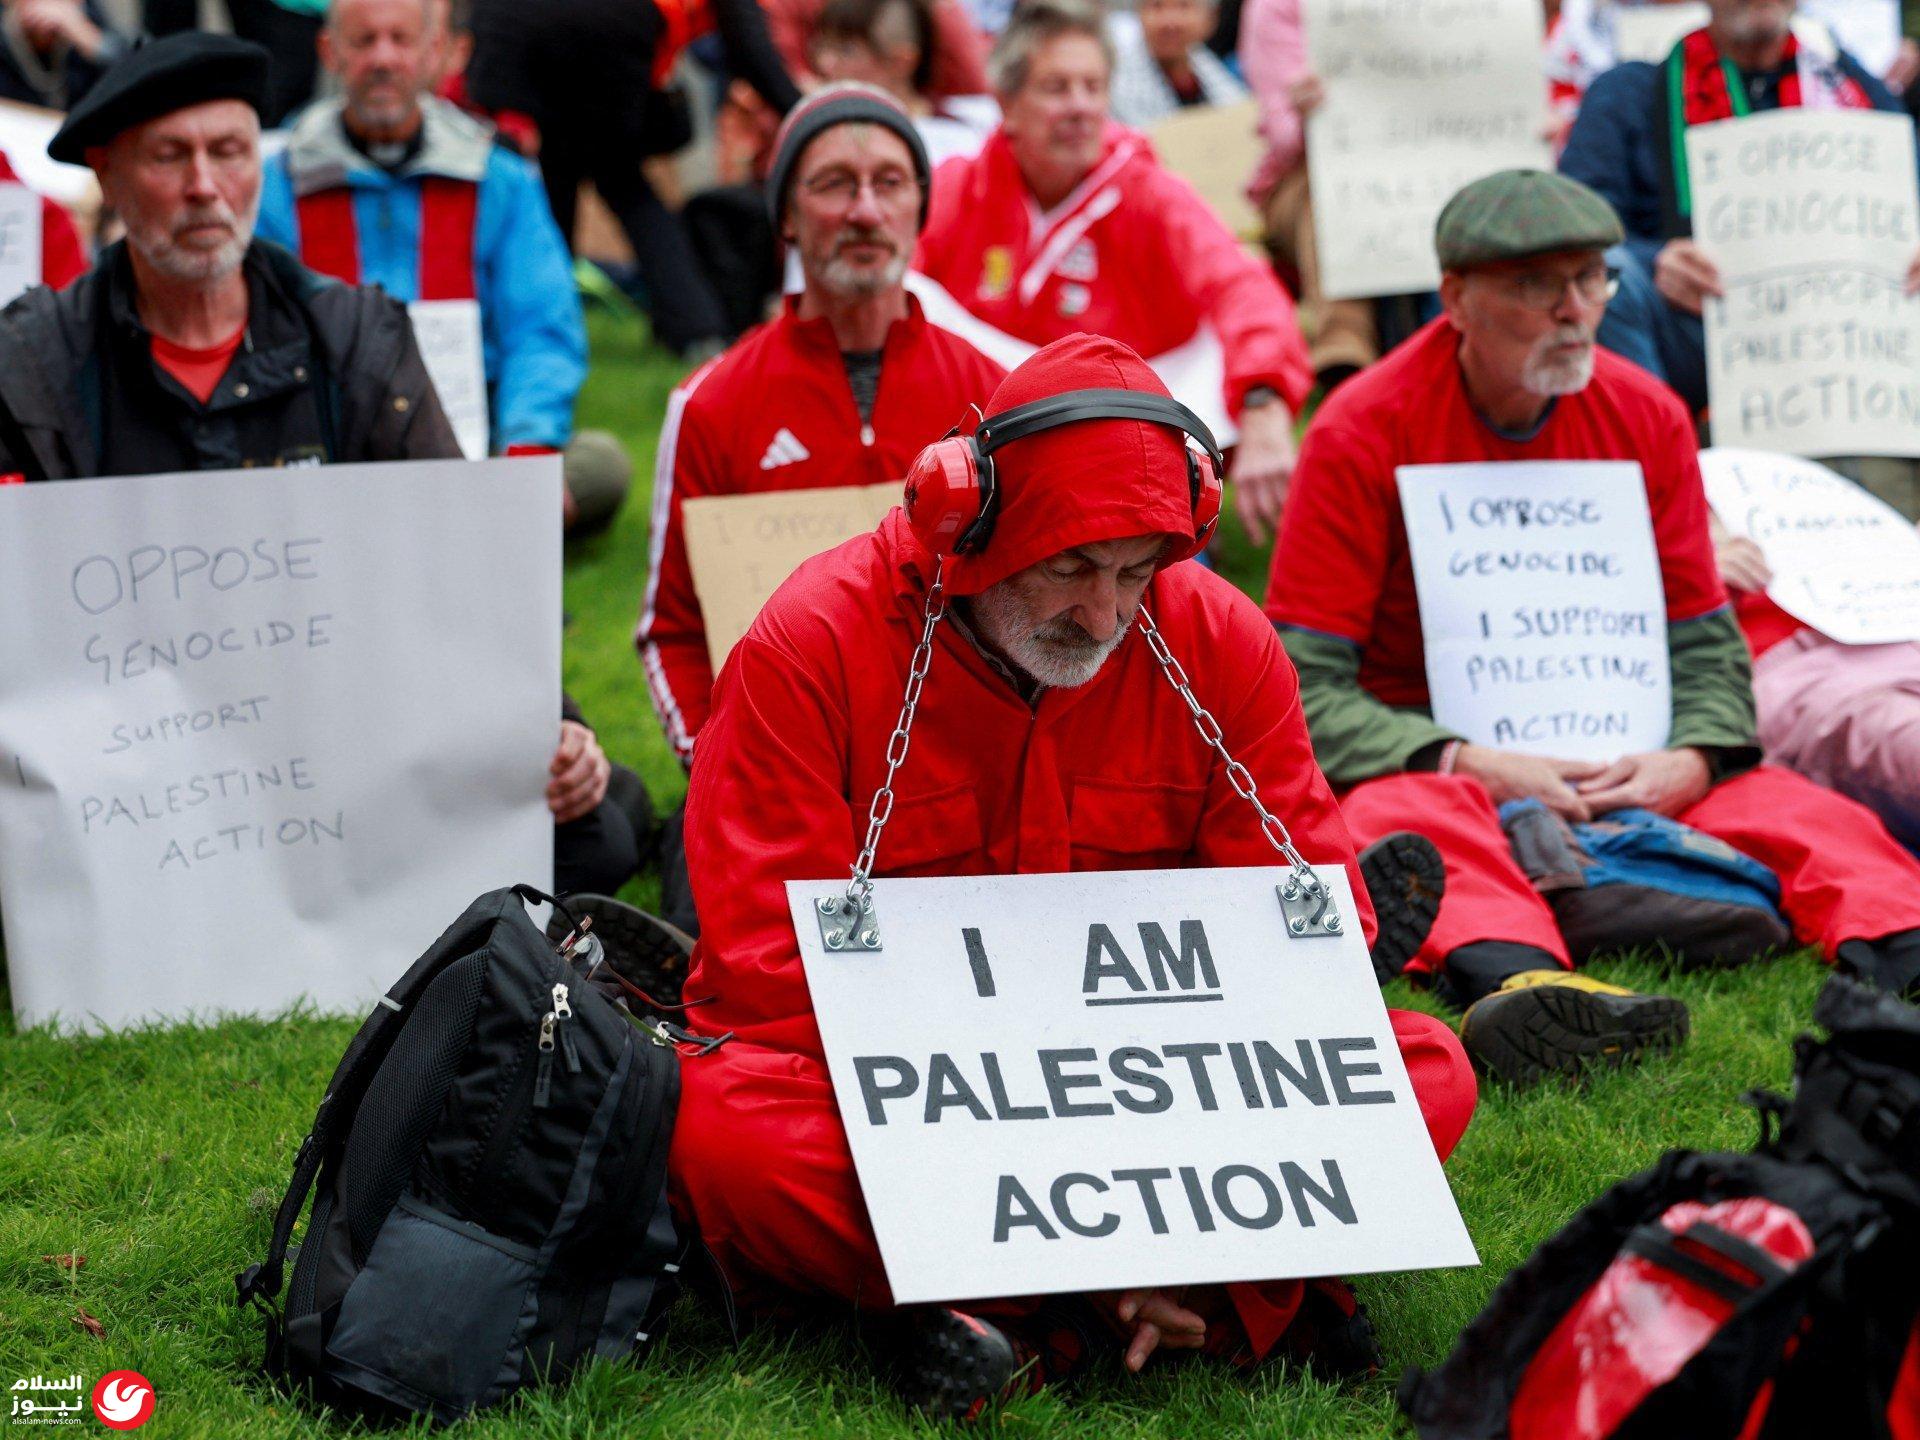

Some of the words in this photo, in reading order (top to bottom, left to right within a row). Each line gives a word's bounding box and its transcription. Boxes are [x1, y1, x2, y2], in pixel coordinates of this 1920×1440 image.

[1738, 131, 1877, 177] OPPOSE
[71, 537, 324, 615] OPPOSE
[1450, 551, 1623, 577] GENOCIDE
[83, 614, 333, 685] GENOCIDE
[1479, 611, 1490, 640] I
[1514, 605, 1648, 639] SUPPORT
[1466, 654, 1658, 693] PALESTINE
[102, 695, 270, 754] SUPPORT
[1494, 711, 1629, 743] ACTION
[81, 756, 316, 834] PALESTINE
[159, 810, 345, 869] ACTION
[962, 927, 996, 997] I
[1082, 919, 1222, 995] AM
[852, 1036, 1396, 1125] PALESTINE
[993, 1159, 1358, 1242] ACTION
